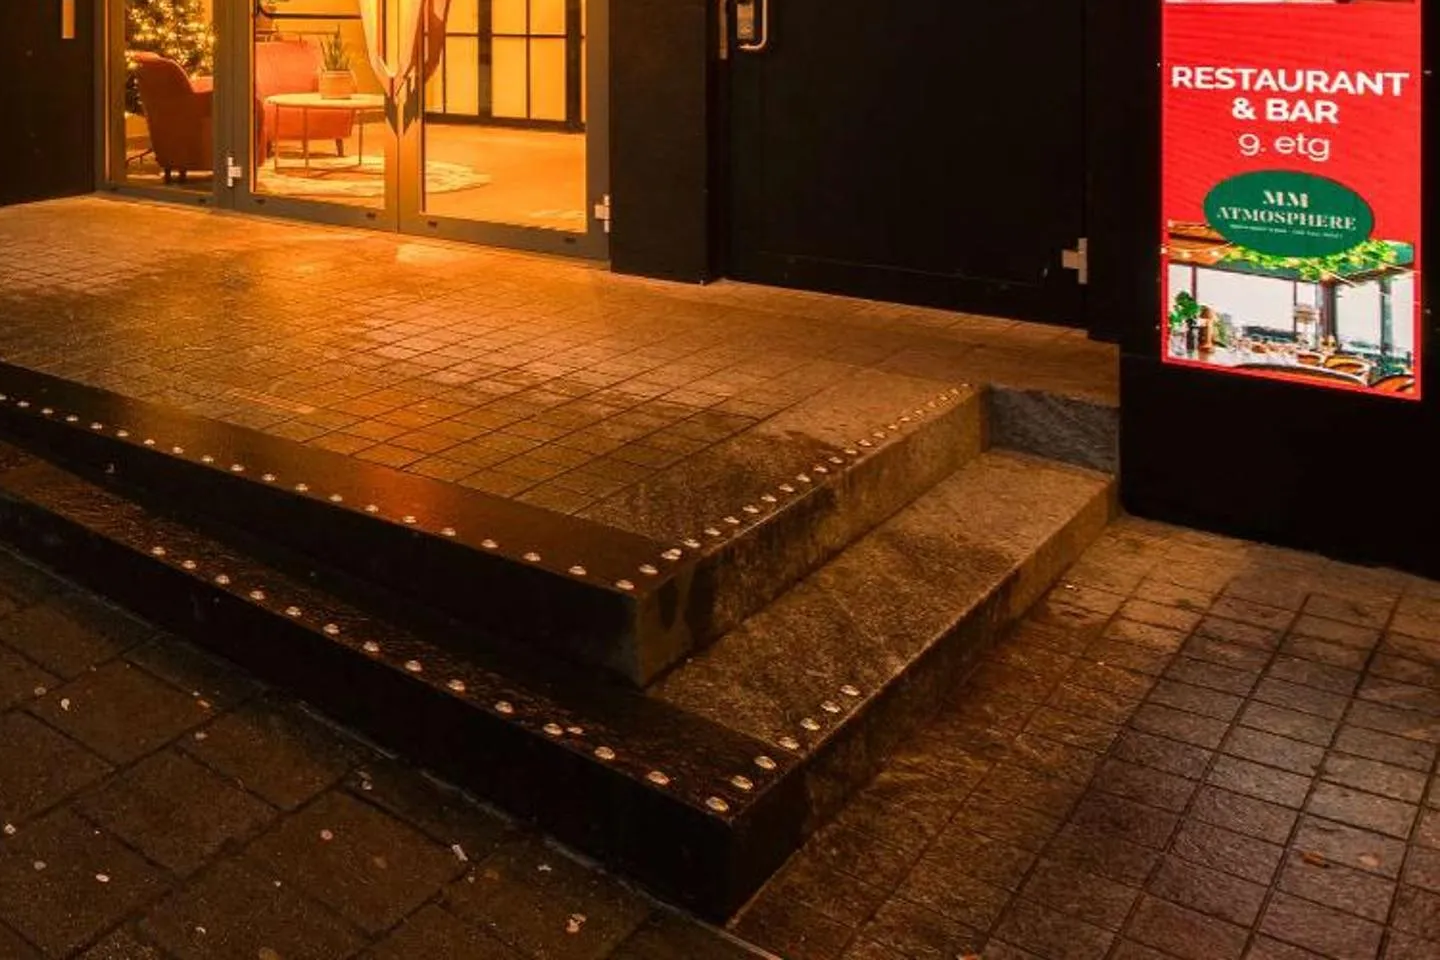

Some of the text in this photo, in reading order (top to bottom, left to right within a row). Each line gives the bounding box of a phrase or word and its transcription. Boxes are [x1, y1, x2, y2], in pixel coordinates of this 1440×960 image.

[1171, 65, 1410, 96] RESTAURANT
[1231, 96, 1339, 124] & BAR
[1238, 132, 1330, 162] 9. etg
[1262, 189, 1311, 209] MM
[1216, 206, 1357, 231] ATMOSPHERE
